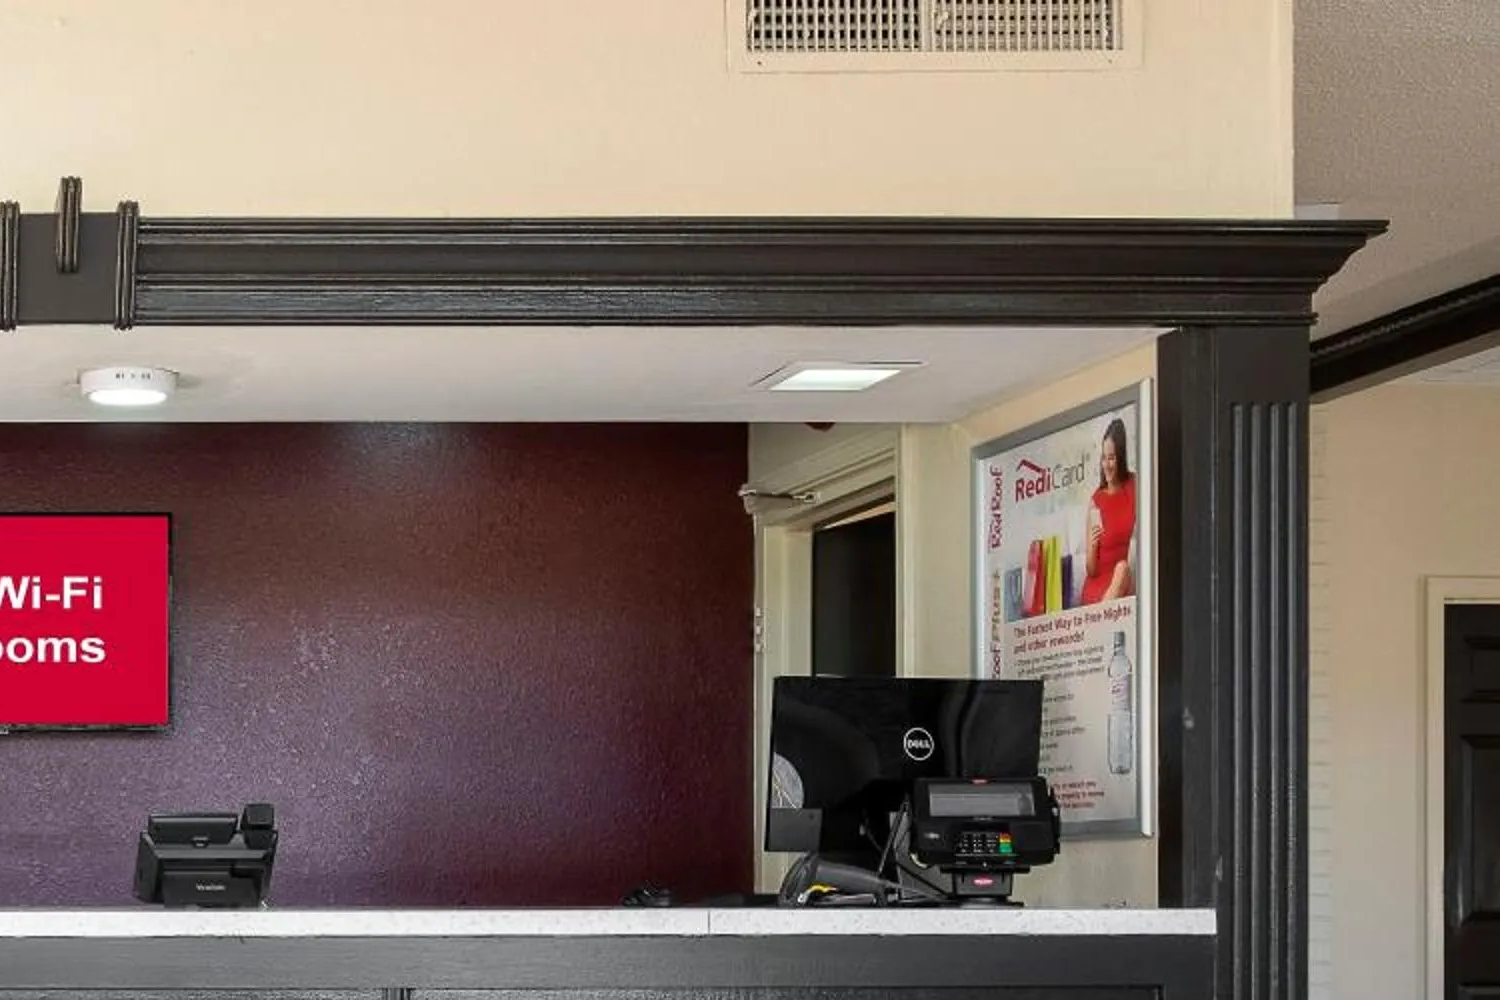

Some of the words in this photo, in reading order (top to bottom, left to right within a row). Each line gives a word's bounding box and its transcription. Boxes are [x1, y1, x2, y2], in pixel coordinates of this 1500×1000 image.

[1014, 450, 1086, 503] RediCard
[1054, 617, 1072, 630] Way
[1073, 615, 1082, 626] to
[1084, 613, 1102, 623] Free
[1103, 605, 1131, 622] Nights
[1013, 640, 1026, 654] and
[1028, 638, 1047, 651] other
